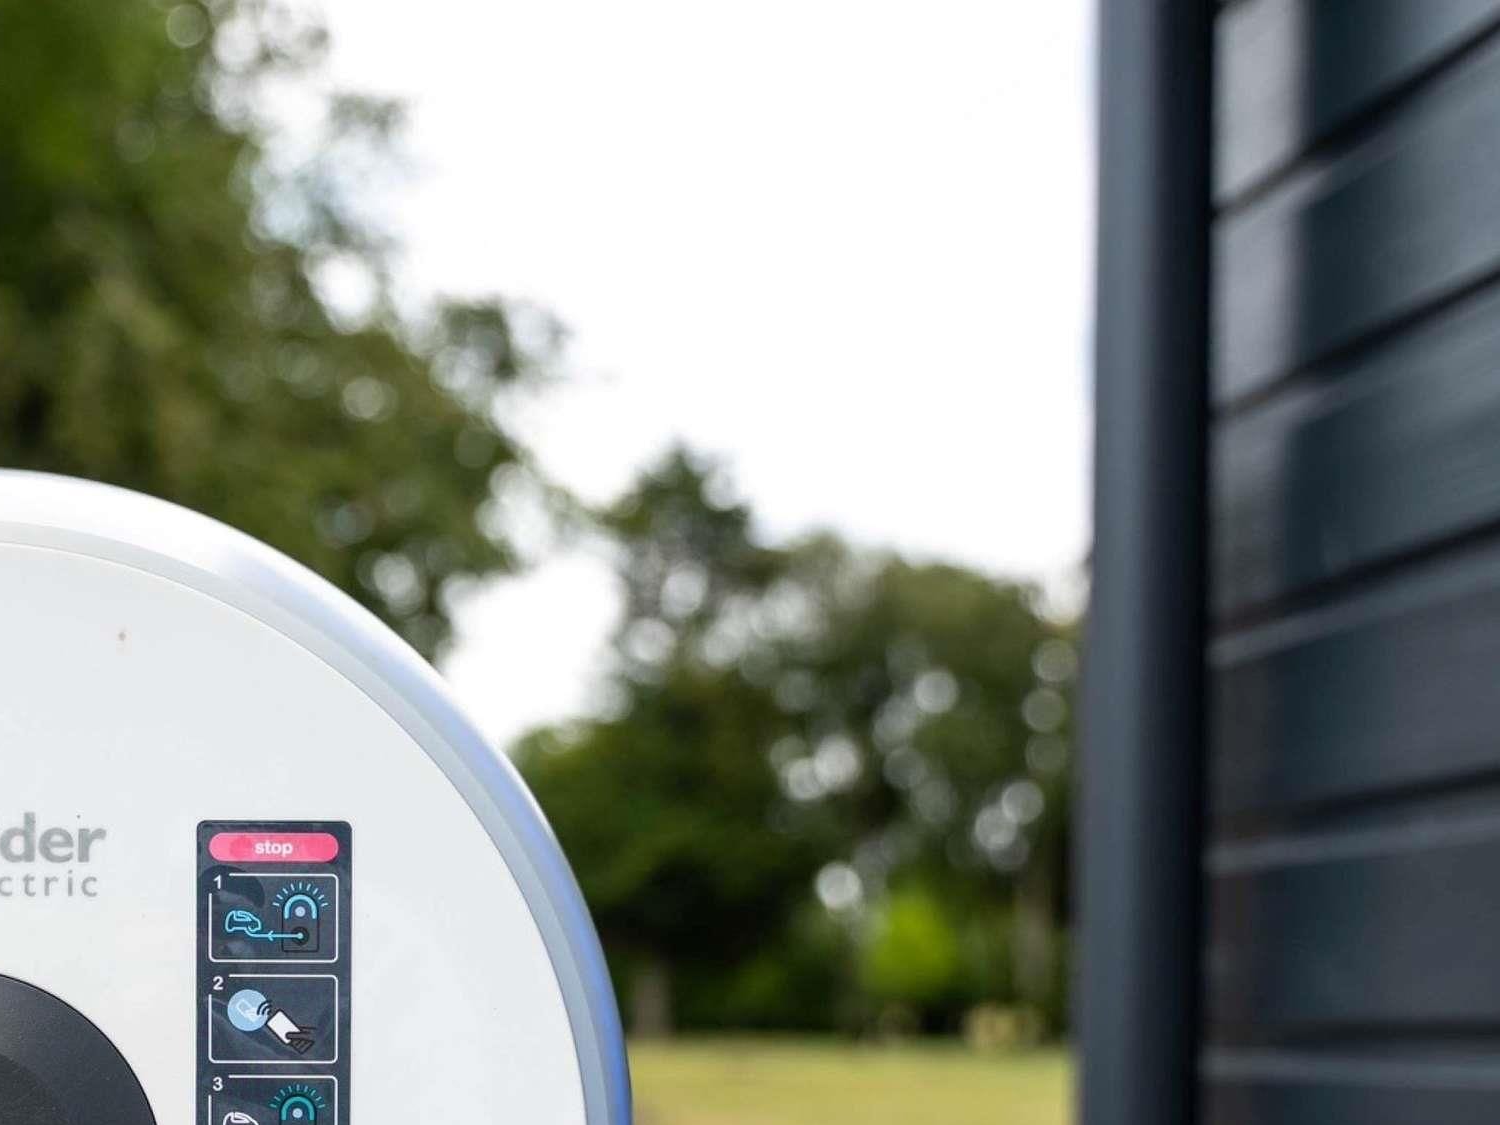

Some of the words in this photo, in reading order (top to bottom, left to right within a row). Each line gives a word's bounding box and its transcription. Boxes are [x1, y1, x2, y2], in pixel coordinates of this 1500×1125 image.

[255, 840, 293, 857] stop
[214, 875, 221, 889] 1
[213, 976, 223, 990] 2
[213, 1077, 223, 1091] 3
